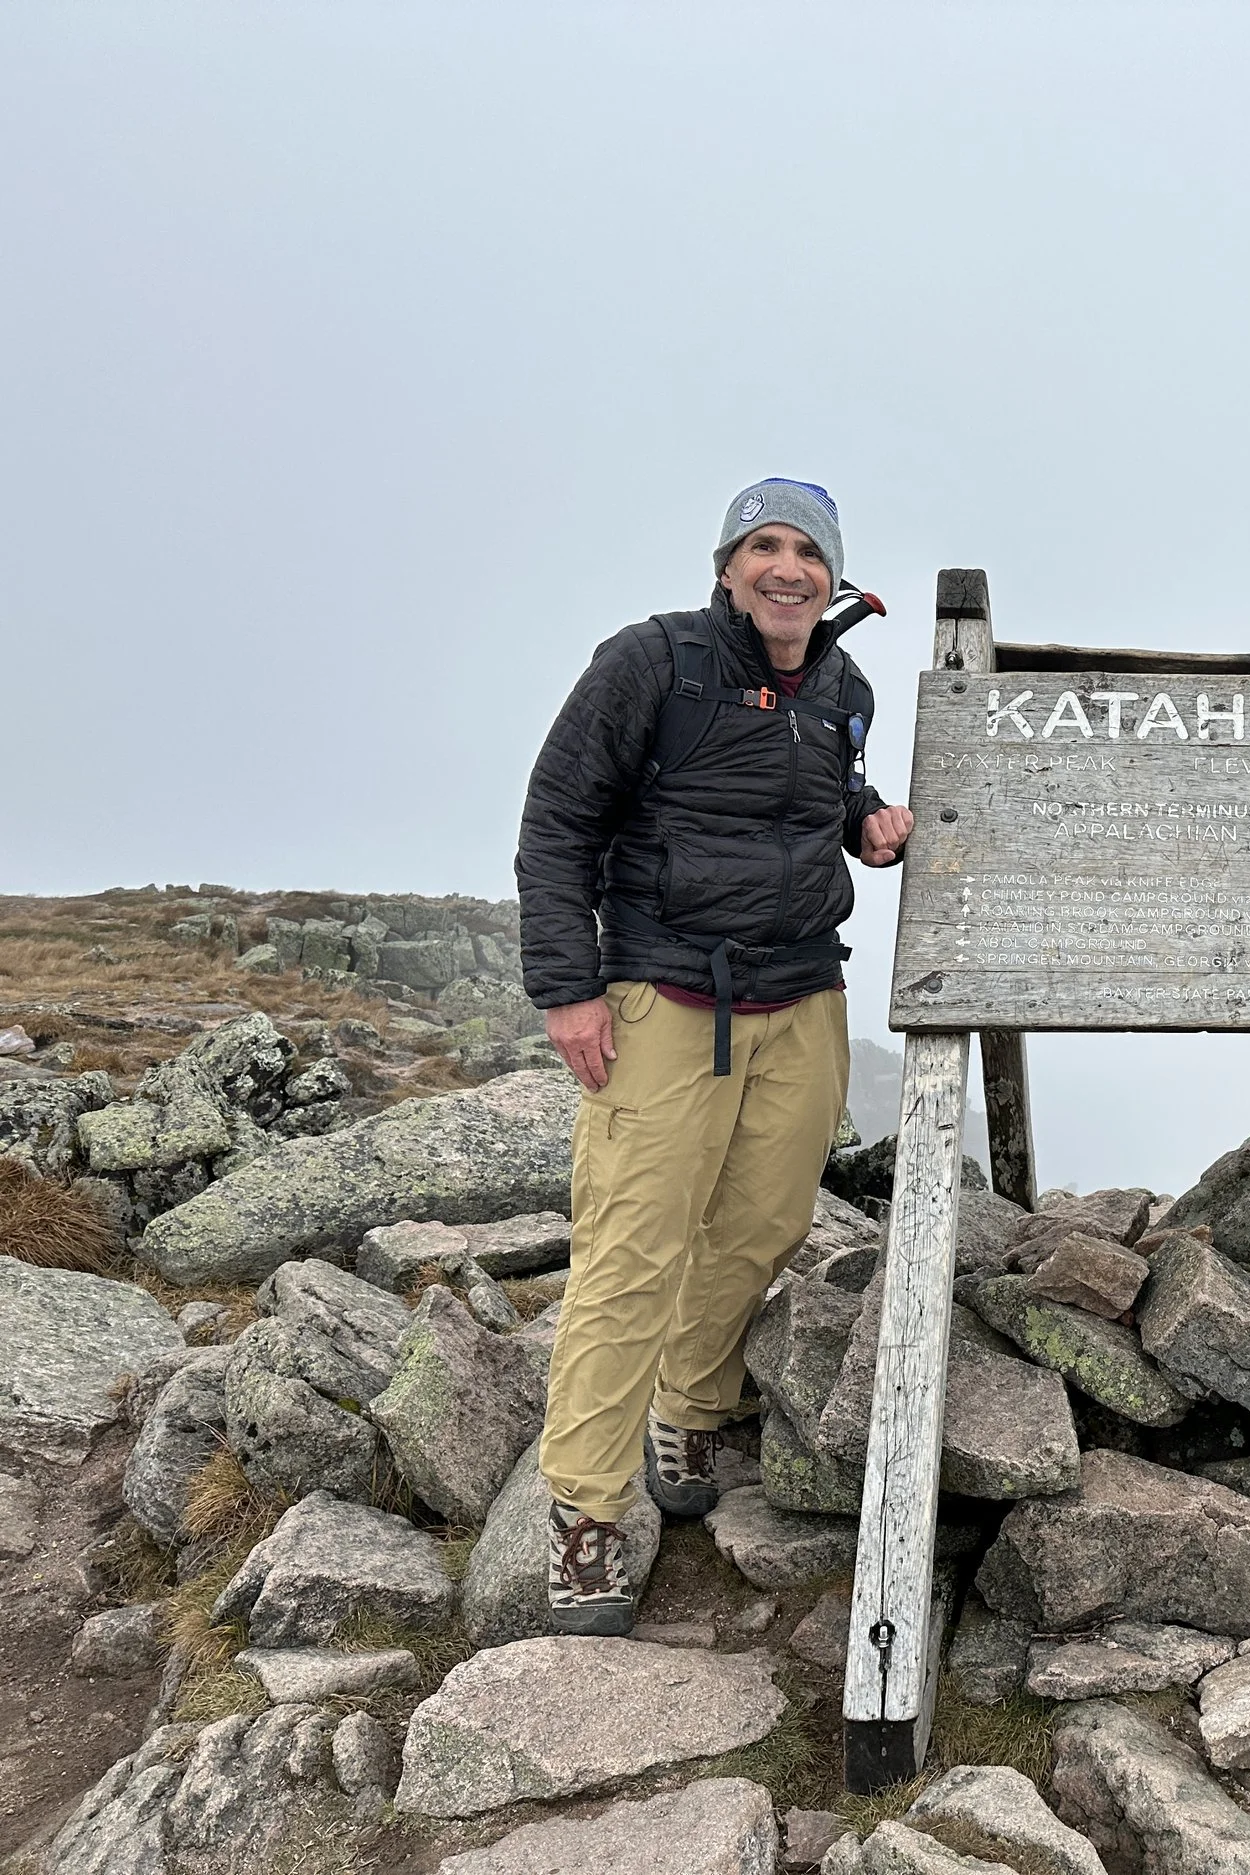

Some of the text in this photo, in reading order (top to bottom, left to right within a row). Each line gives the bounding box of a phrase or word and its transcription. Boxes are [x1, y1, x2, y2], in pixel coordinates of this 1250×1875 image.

[1049, 754, 1117, 771] PEAK
[1053, 823, 1237, 842] APPALACHIAN
[982, 874, 1048, 885] PAMOLA
[1053, 875, 1096, 886] PEAK
[1100, 878, 1122, 887] via
[1127, 876, 1174, 887] KNIFE
[981, 889, 1056, 901] CHIMNEY
[1060, 890, 1105, 902] POND
[1111, 892, 1227, 904] CAMPGROUND
[980, 904, 1055, 917] ROARING
[1060, 906, 1119, 918] BROOK
[1124, 907, 1241, 920] CAMPGROUND
[979, 921, 1062, 933] KATAHDIN
[1067, 922, 1134, 934] STREAM
[977, 937, 1022, 949] ABOL
[1027, 937, 1147, 950] CAMPGROUND
[976, 953, 1061, 965] SPRINGER
[1066, 954, 1158, 968] MOUNTAIN,
[1164, 955, 1239, 968] GEORGIA
[1102, 987, 1166, 1000] BAXTER
[1171, 987, 1220, 1000] STATE
